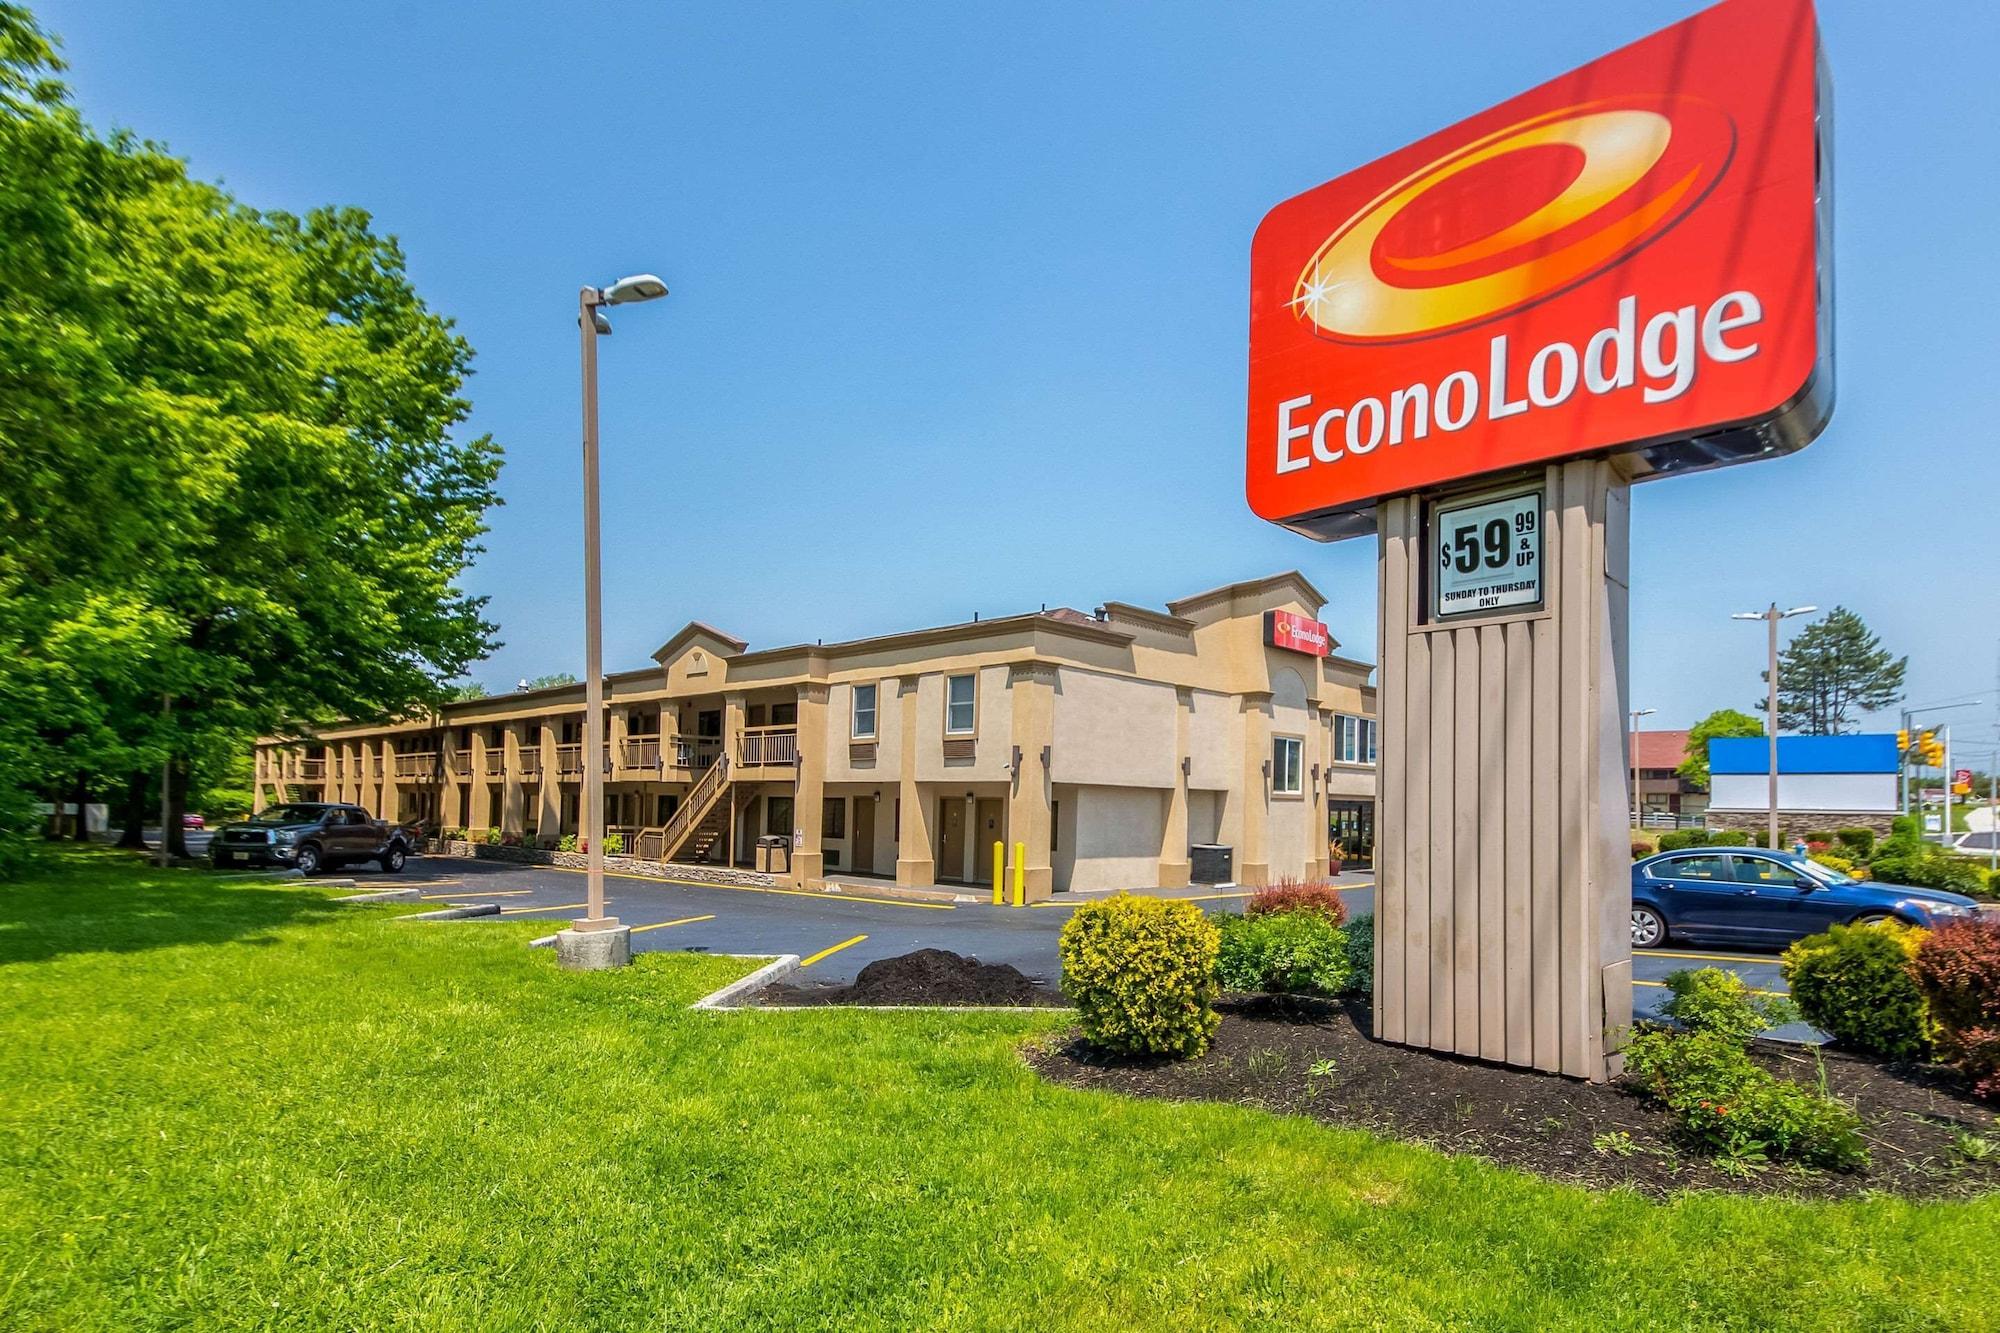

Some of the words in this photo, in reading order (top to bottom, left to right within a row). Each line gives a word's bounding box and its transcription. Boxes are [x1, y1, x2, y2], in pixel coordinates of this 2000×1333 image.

[1520, 538, 1530, 550] &
[1516, 551, 1535, 567] UP
[1445, 588, 1477, 602] SUNDAY
[1478, 586, 1489, 597] TO
[1491, 579, 1536, 595] THURSDAY
[1479, 596, 1500, 607] ONLY
